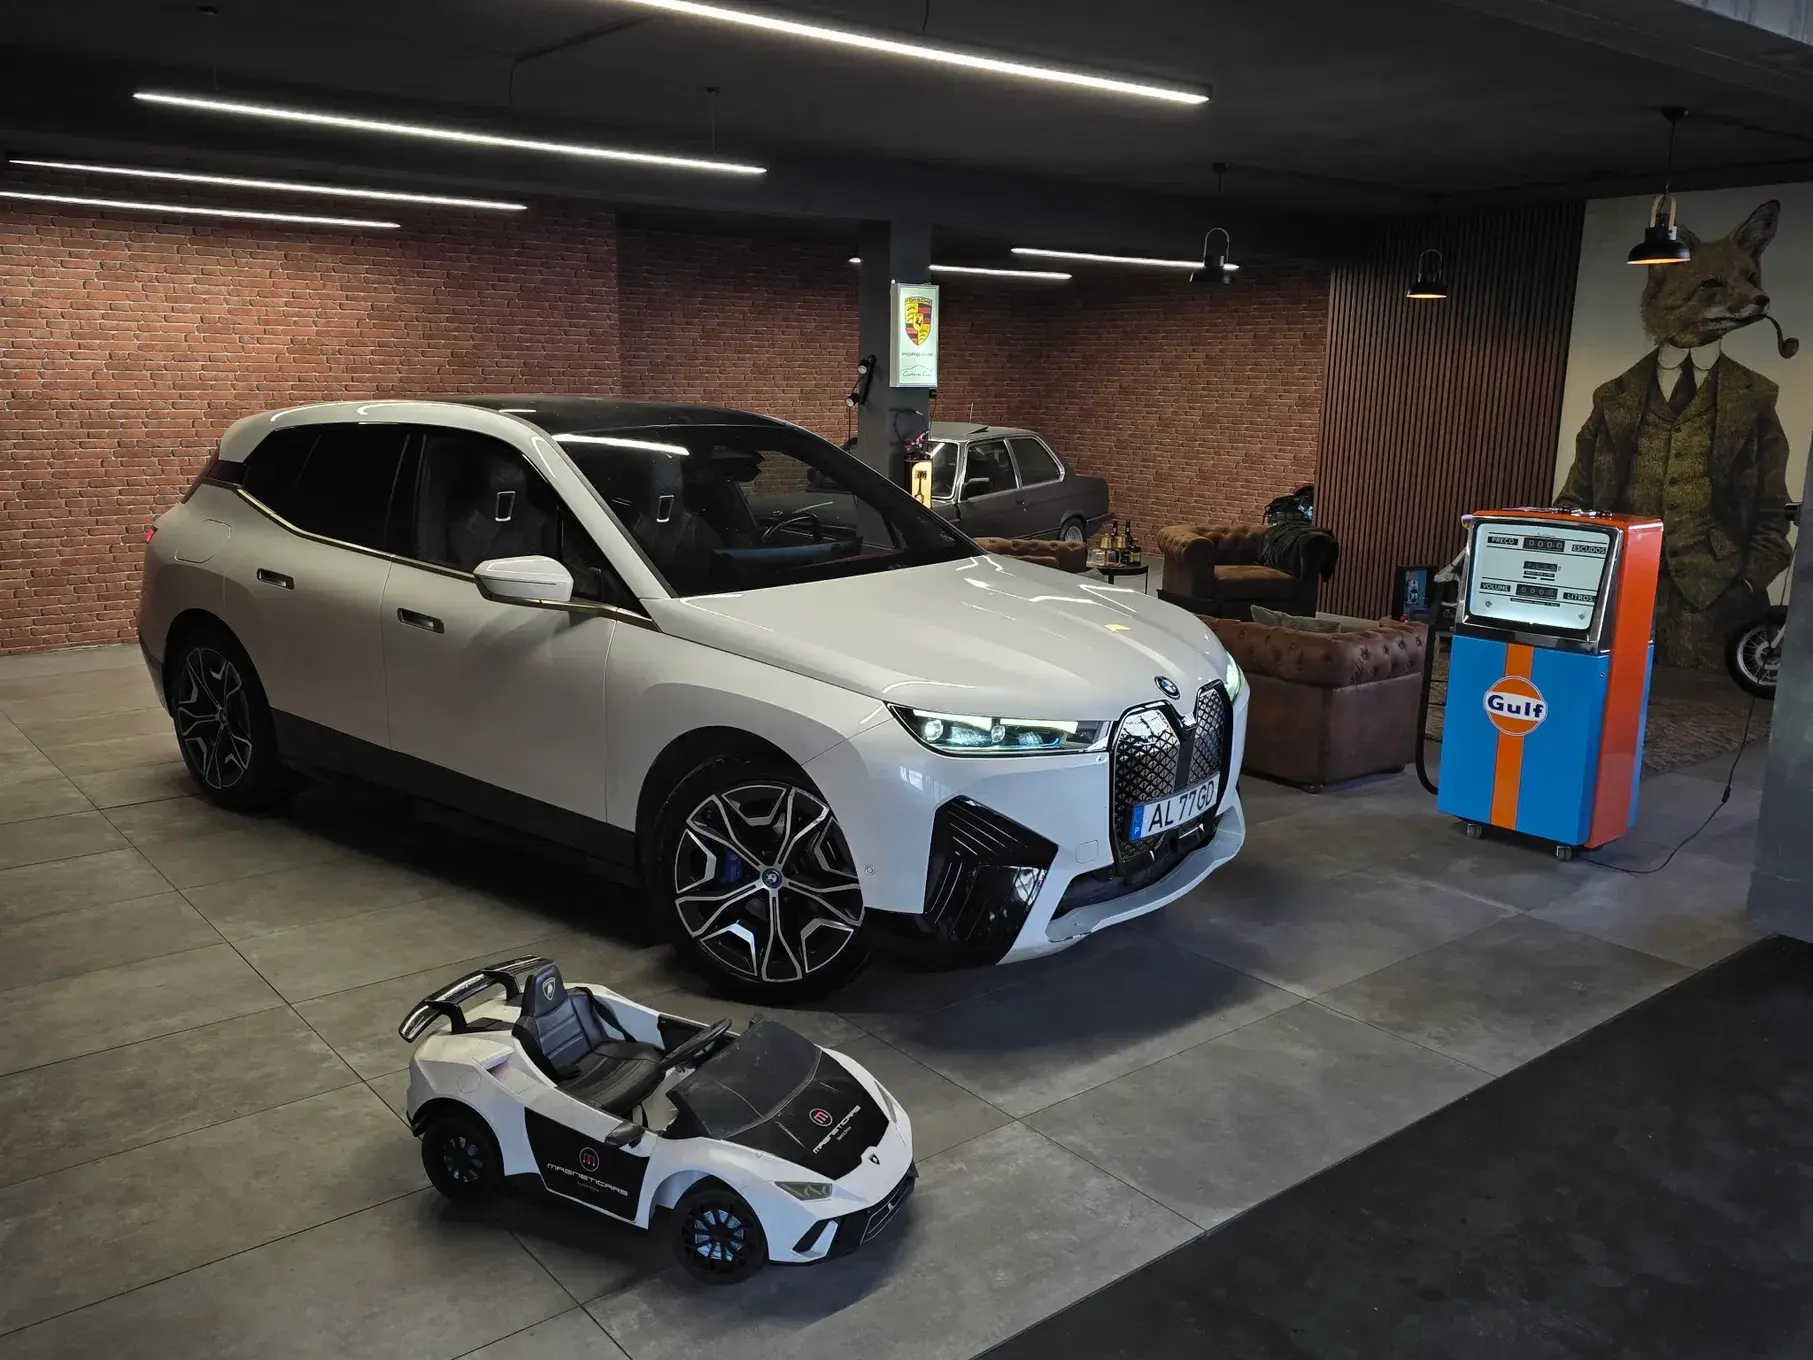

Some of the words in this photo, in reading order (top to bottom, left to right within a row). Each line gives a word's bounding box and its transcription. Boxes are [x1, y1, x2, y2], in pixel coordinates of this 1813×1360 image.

[1573, 544, 1606, 555] ESCUDOS
[1482, 582, 1510, 592] VOLUME
[1567, 593, 1594, 602] LITROS
[1487, 694, 1544, 718] Gulf
[1148, 800, 1174, 832] AL
[1179, 789, 1197, 821] 77
[1197, 780, 1215, 811] GD
[547, 1162, 629, 1197] MAGNETICARS
